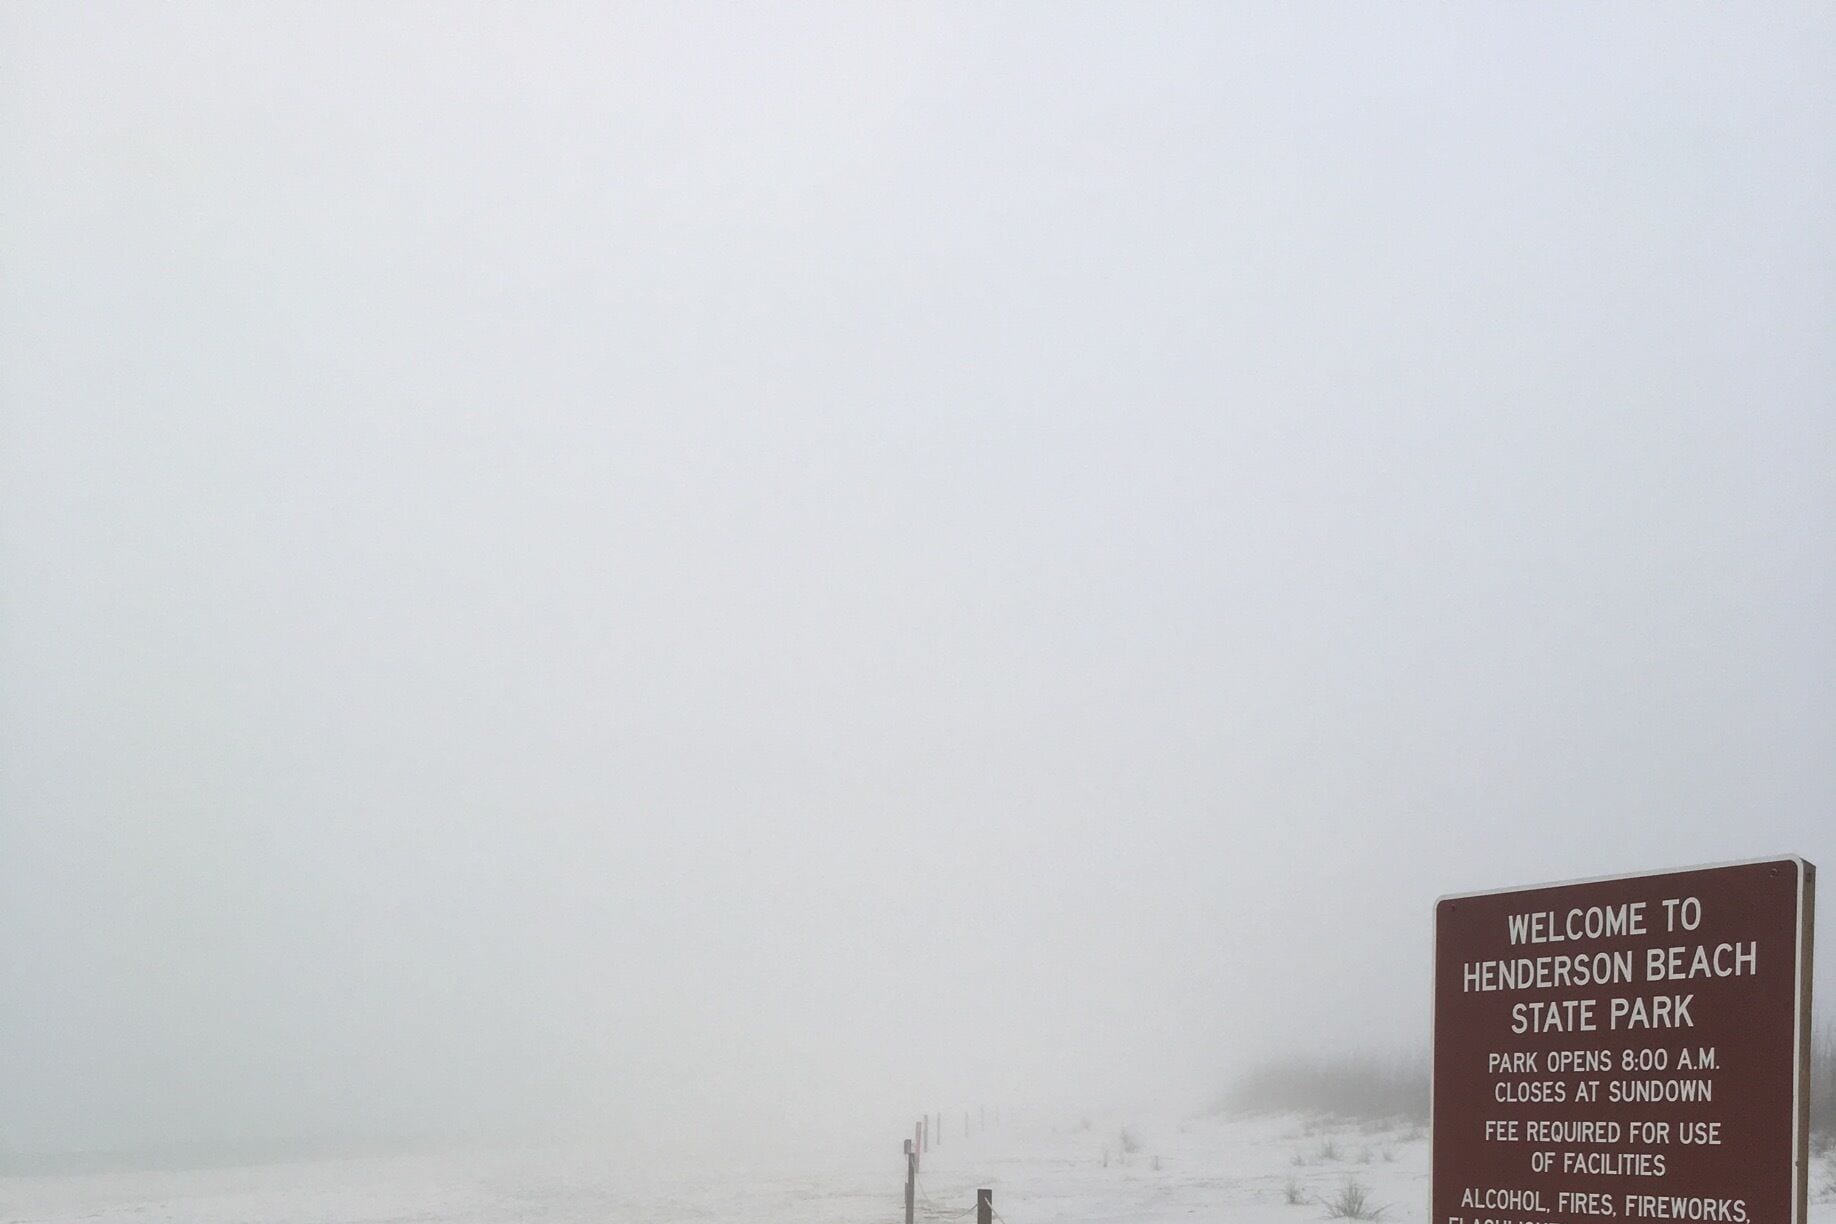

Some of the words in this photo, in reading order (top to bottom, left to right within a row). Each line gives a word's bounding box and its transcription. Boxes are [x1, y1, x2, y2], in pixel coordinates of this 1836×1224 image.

[1509, 902, 1647, 945] WELCOME
[1663, 897, 1701, 931] TO
[1464, 951, 1633, 992] HENDERSON
[1647, 941, 1756, 979] BEACH
[1512, 999, 1596, 1034] STATE
[1611, 995, 1694, 1029] PARK
[1489, 1051, 1537, 1073] PARK
[1547, 1051, 1611, 1072] OPENS
[1622, 1049, 1667, 1070] 8:00
[1677, 1048, 1720, 1069] A.M.
[1495, 1081, 1566, 1101] CLOSES
[1576, 1081, 1600, 1101] AT
[1609, 1080, 1712, 1101] SUNDOWN
[1486, 1121, 1518, 1141] FEE
[1527, 1121, 1620, 1143] REQUIRED
[1630, 1122, 1670, 1144] FOR
[1679, 1122, 1721, 1145] USE
[1531, 1152, 1555, 1172] OF
[1564, 1153, 1665, 1176] FACILITIES
[1461, 1188, 1550, 1213] ALCOHOL,
[1559, 1192, 1616, 1217] FIRES,
[1625, 1195, 1751, 1224] FIREWORKS,
